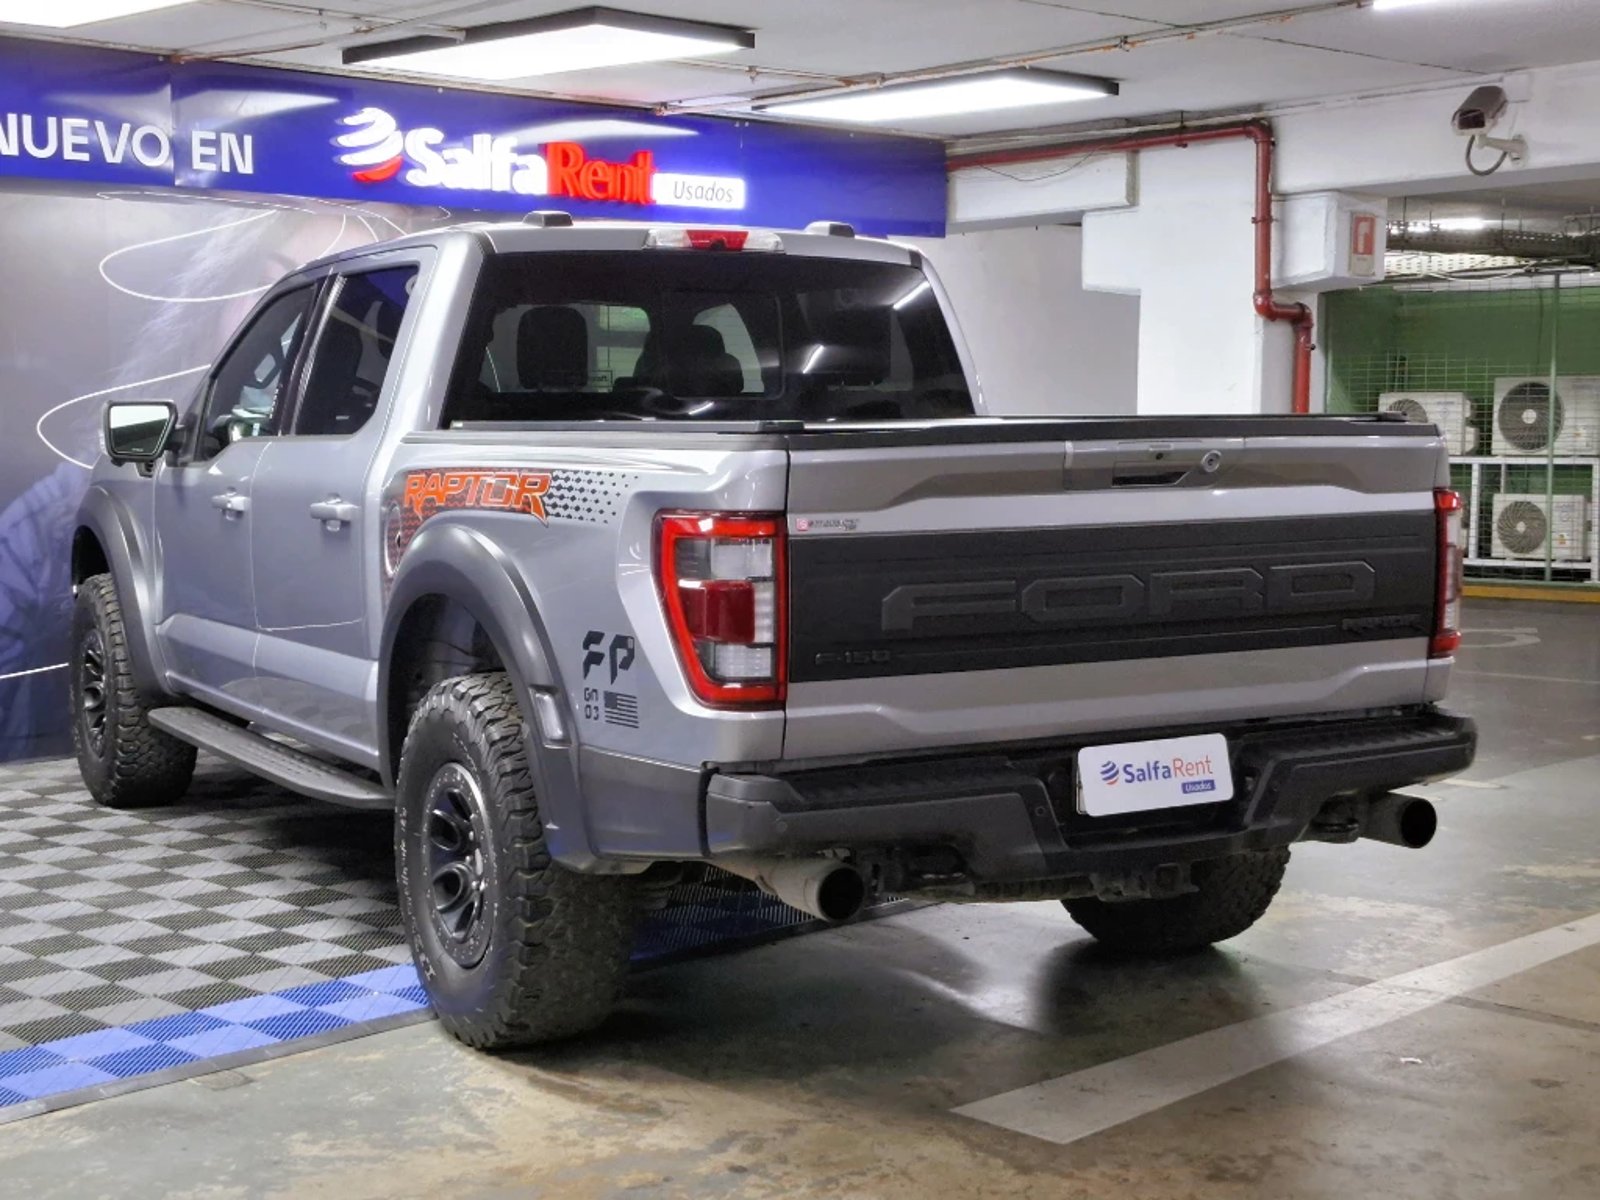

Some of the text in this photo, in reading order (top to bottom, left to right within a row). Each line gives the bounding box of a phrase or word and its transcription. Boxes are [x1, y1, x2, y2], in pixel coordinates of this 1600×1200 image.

[0, 112, 254, 175] NUEVO EN
[672, 180, 734, 205] Usados
[403, 471, 552, 528] RAPTOR
[880, 559, 1376, 632] FORD
[1185, 782, 1212, 793] Usados
